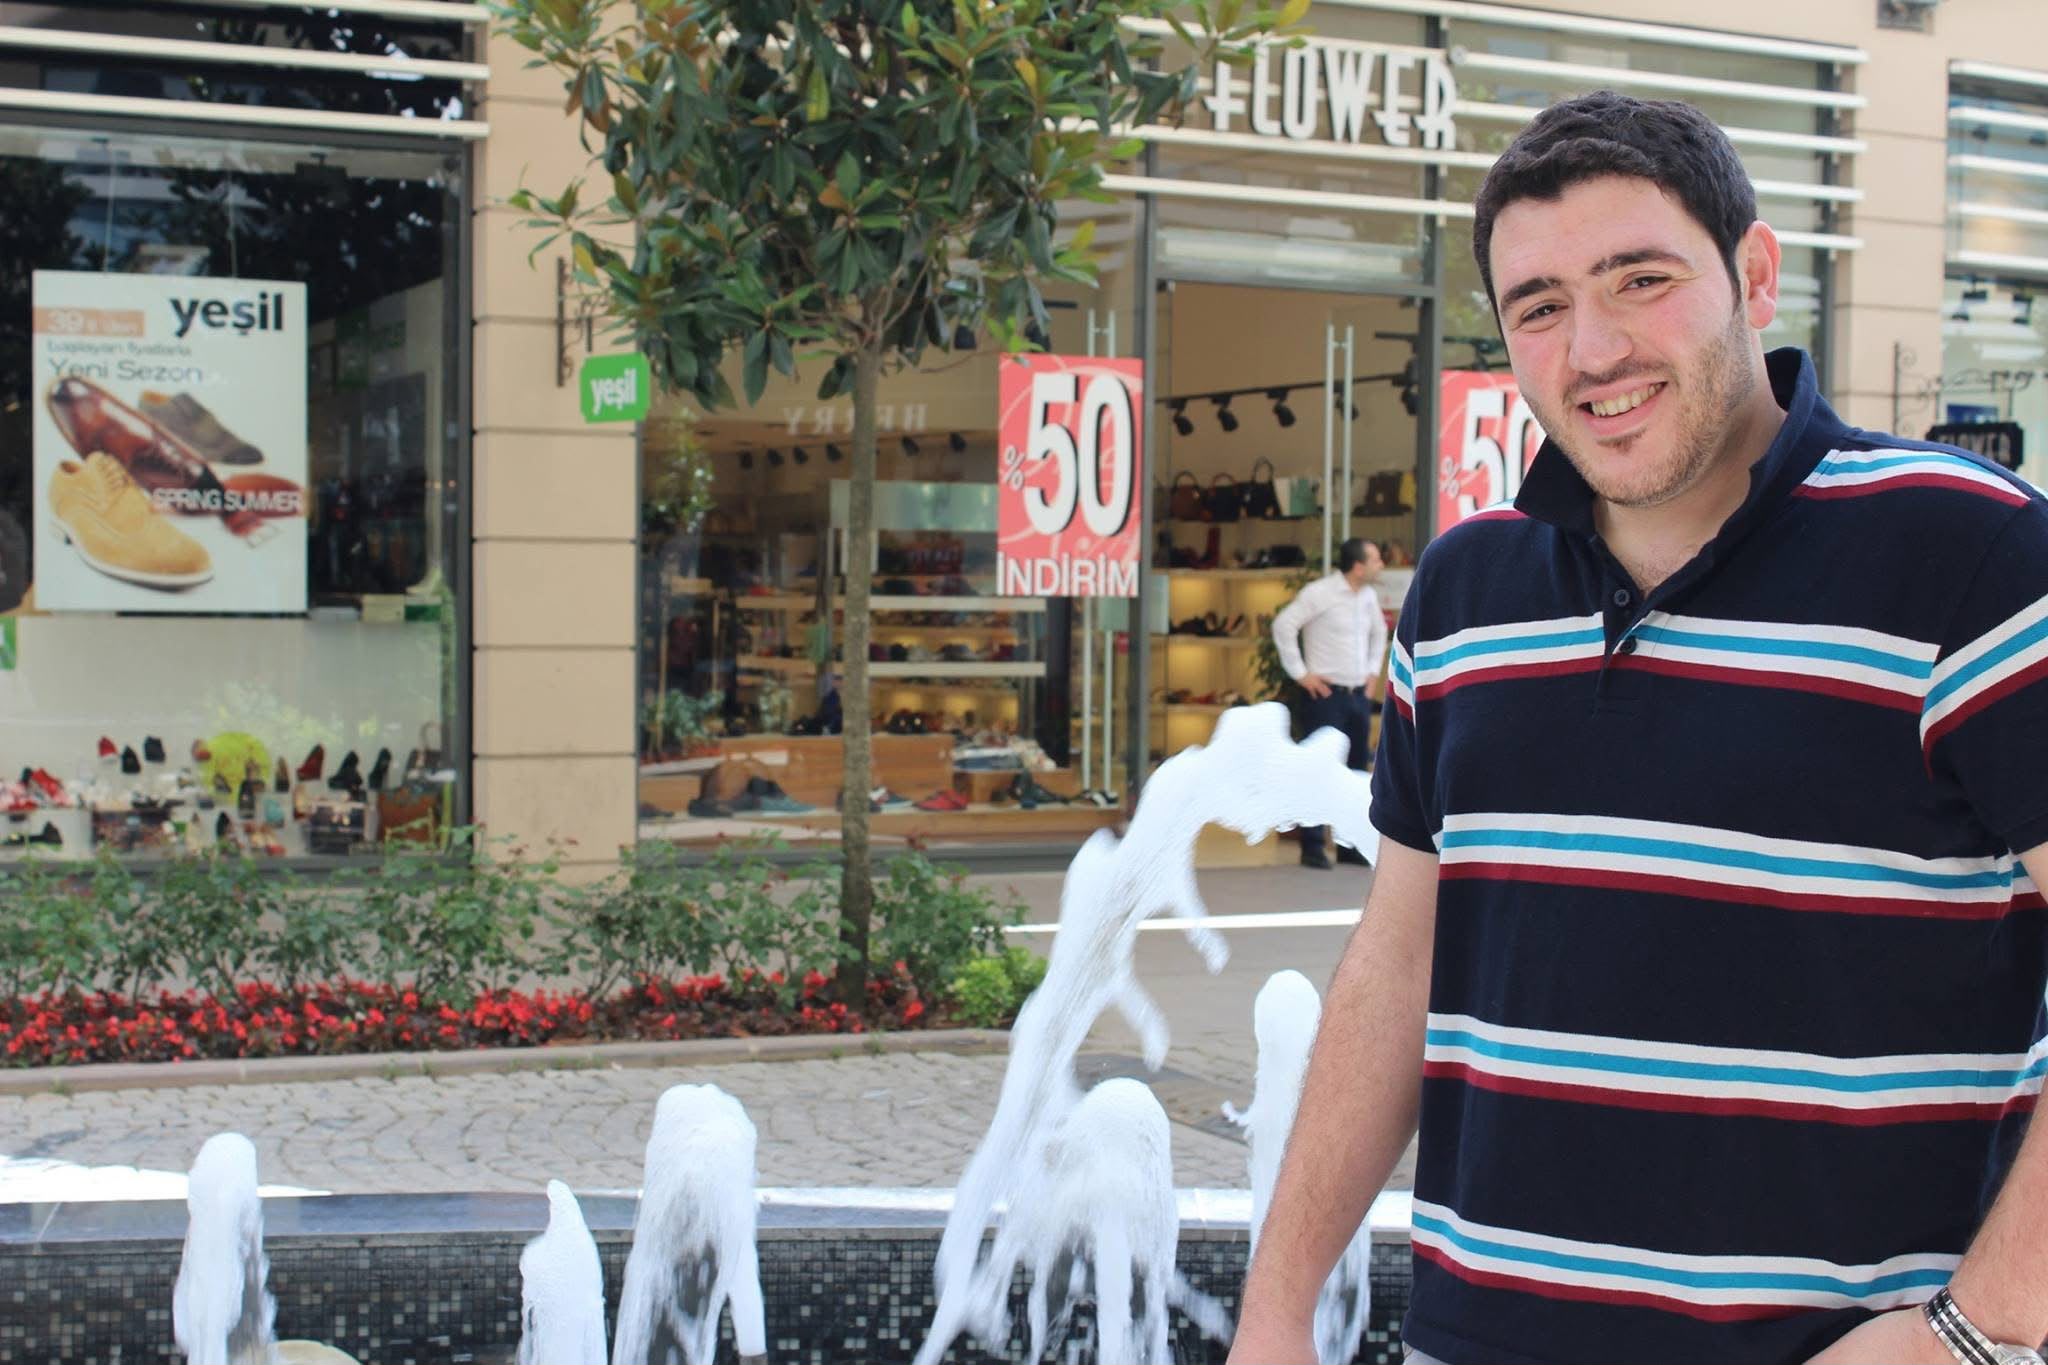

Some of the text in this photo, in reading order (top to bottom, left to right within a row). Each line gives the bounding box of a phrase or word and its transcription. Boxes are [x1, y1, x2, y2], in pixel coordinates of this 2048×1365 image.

[1203, 44, 1457, 151] FLOWER
[170, 291, 284, 338] yeşil
[48, 358, 203, 382] Yeni Sezon
[590, 367, 637, 417] yeşil
[223, 488, 304, 513] SUMMER
[996, 552, 1140, 598] İNDİRİM
